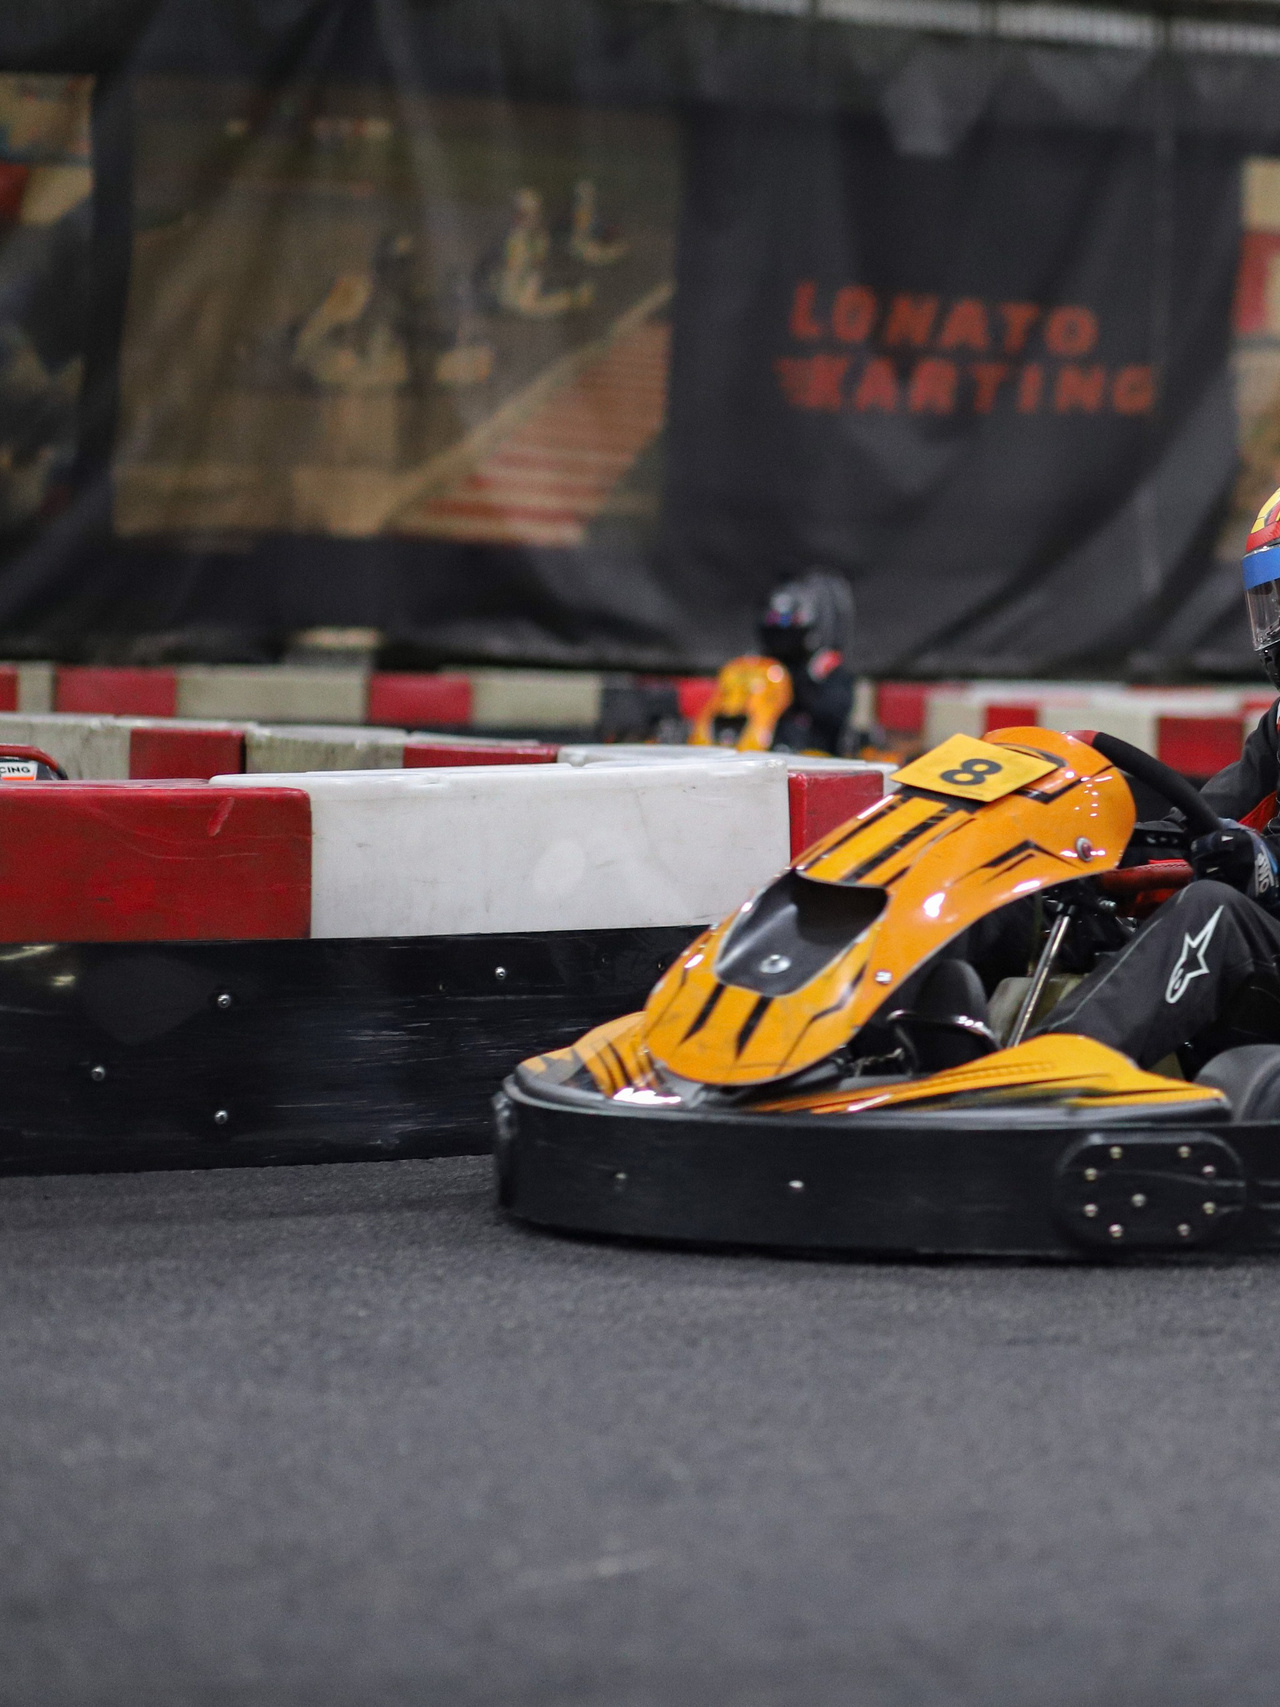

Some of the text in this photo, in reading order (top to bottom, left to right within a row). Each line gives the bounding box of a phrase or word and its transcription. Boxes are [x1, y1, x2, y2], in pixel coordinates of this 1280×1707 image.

[789, 281, 1099, 357] LONATO
[776, 354, 1156, 414] KARTING
[940, 758, 1003, 786] 8
